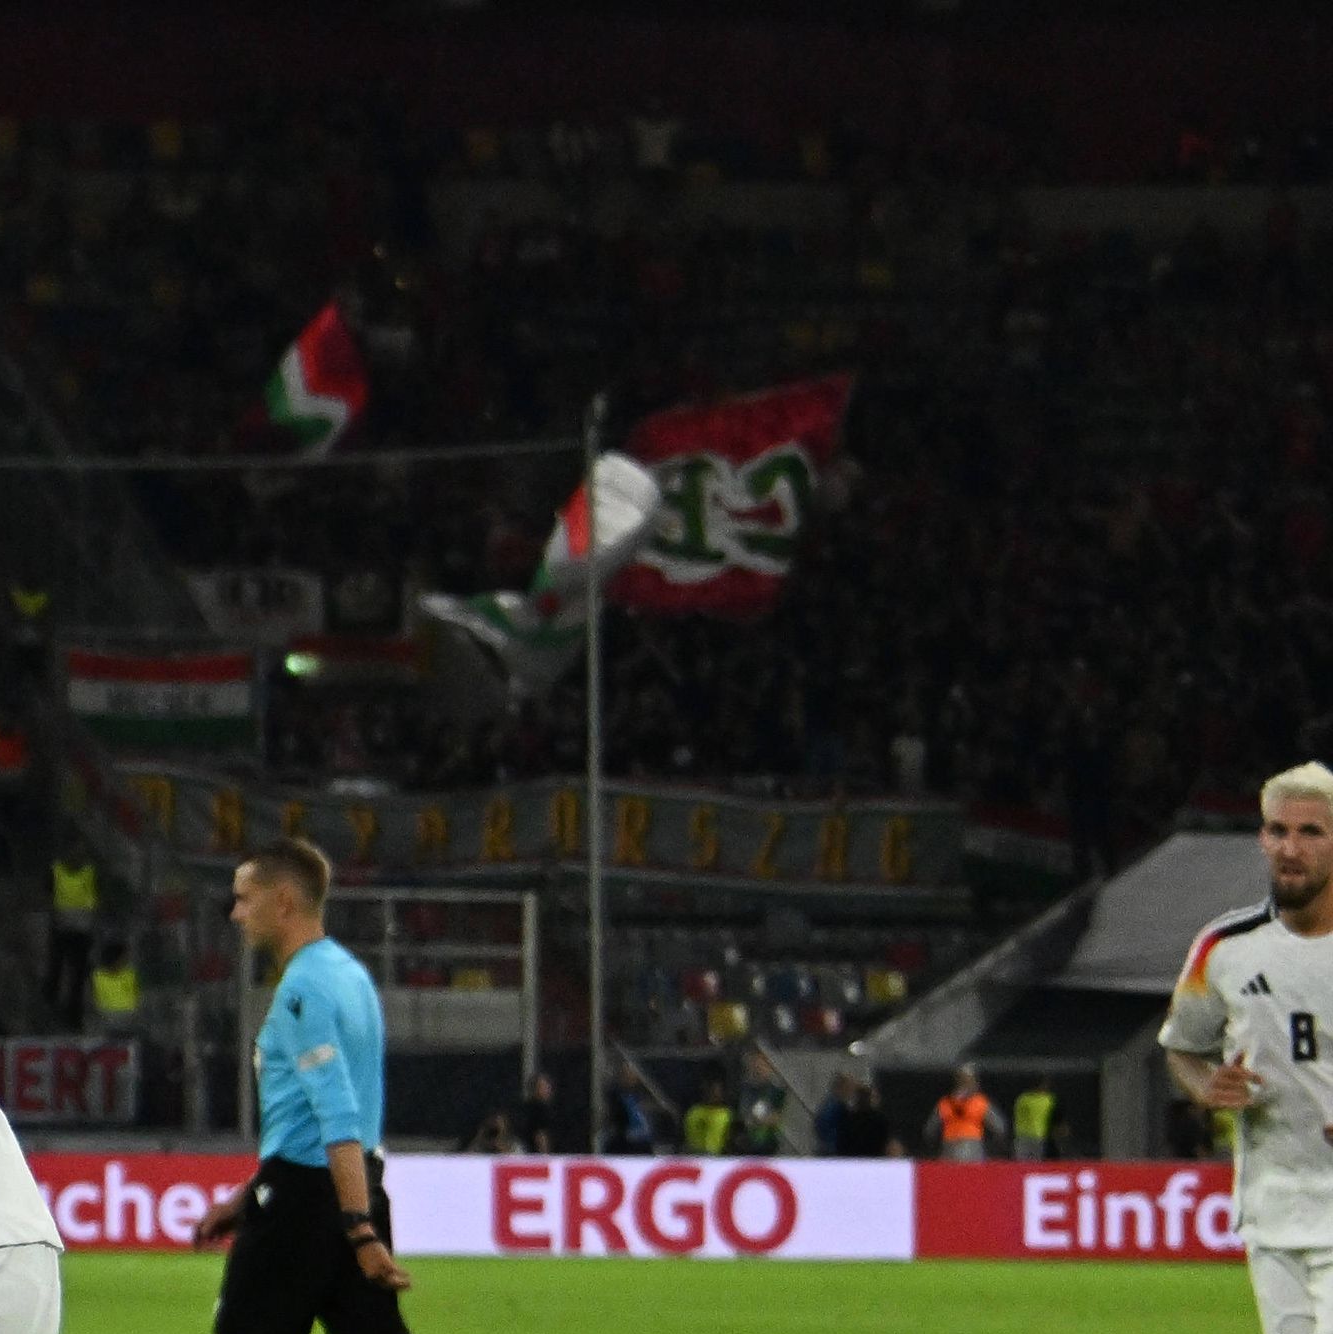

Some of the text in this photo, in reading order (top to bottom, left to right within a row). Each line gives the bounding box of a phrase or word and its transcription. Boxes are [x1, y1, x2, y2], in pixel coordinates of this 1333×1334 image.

[1290, 1011, 1317, 1061] 8
[492, 1164, 798, 1254] ERGO
[1023, 1169, 1245, 1250] Einfa
